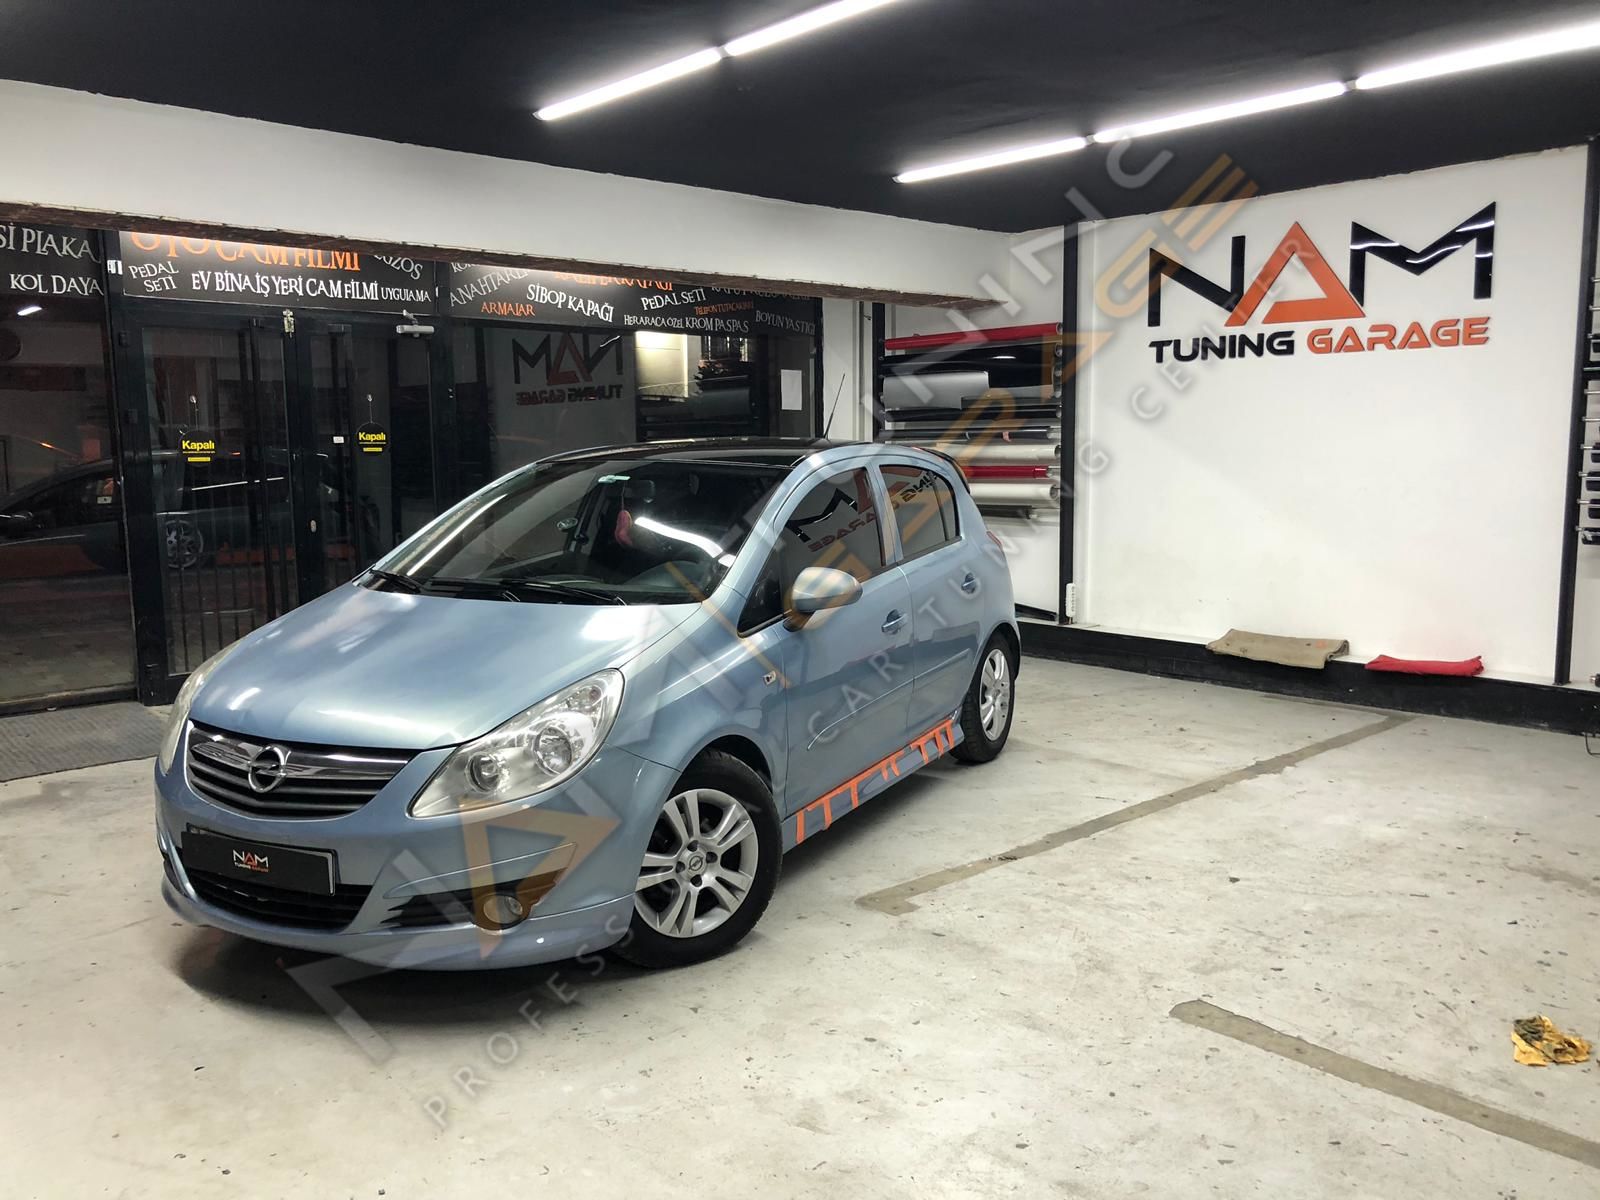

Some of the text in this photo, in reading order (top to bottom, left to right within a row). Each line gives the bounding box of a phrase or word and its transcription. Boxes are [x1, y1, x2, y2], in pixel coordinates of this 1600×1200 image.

[21, 227, 101, 263] PLAKA
[128, 261, 180, 279] PEDAL
[1148, 201, 1496, 327] NAM
[9, 273, 104, 296] KOL DAYA
[191, 270, 211, 290] EV
[214, 270, 256, 293] BİNA
[270, 275, 304, 296] YERİ
[305, 278, 342, 298] CAM
[344, 279, 379, 301] FİLMİ
[526, 282, 615, 323] SİBOP KAPAĞI
[640, 291, 681, 311] PEDAL
[685, 316, 713, 331] KROM
[1149, 316, 1491, 364] TUNING GARAGE
[182, 439, 215, 451] Kapalı
[358, 431, 386, 442] Kapalı
[233, 849, 269, 868] NAM
